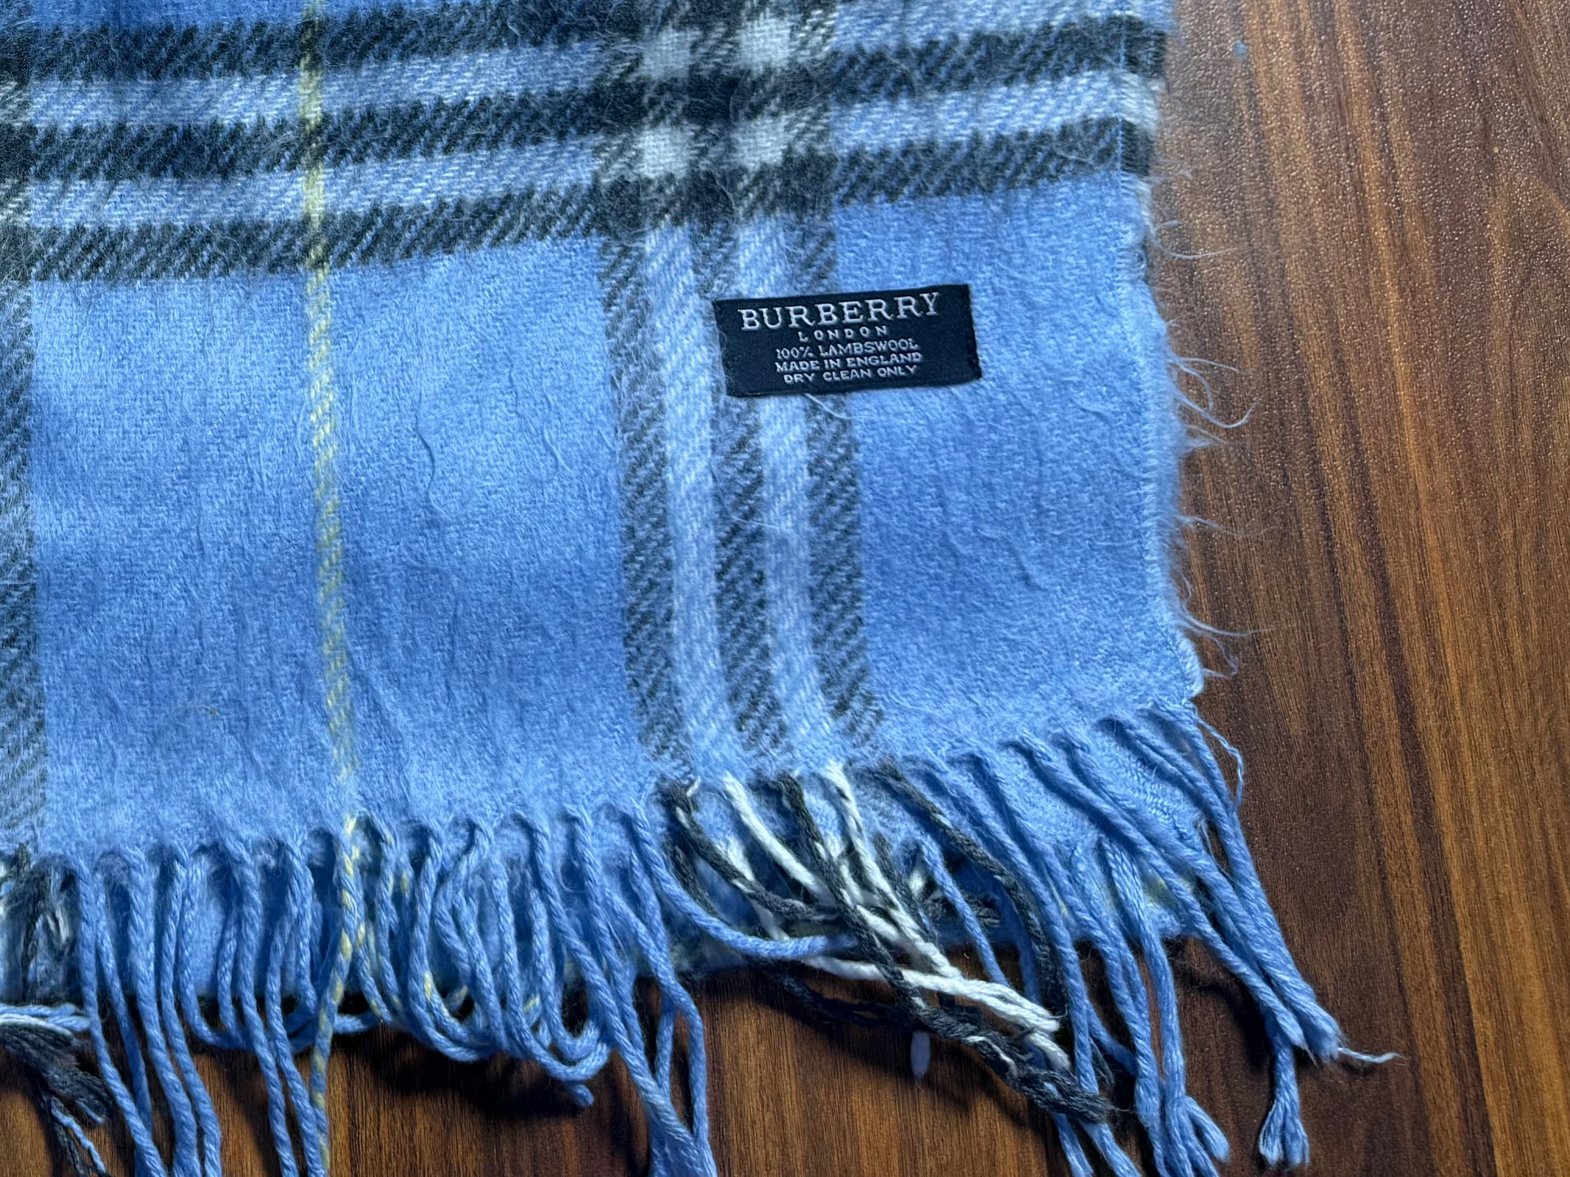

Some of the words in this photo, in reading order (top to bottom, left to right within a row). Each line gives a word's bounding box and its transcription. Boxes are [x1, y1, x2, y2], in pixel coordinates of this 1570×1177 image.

[737, 291, 940, 331] BURBERRY
[798, 325, 889, 343] LONDON
[775, 345, 815, 359] 100%
[819, 338, 920, 357] LAMBSWOOL
[775, 359, 820, 373] MADE
[824, 358, 842, 370] IN
[847, 352, 923, 368] ENGLAND
[783, 372, 816, 384] DRY
[823, 368, 873, 382] CLEAN
[877, 364, 918, 377] ONLY
